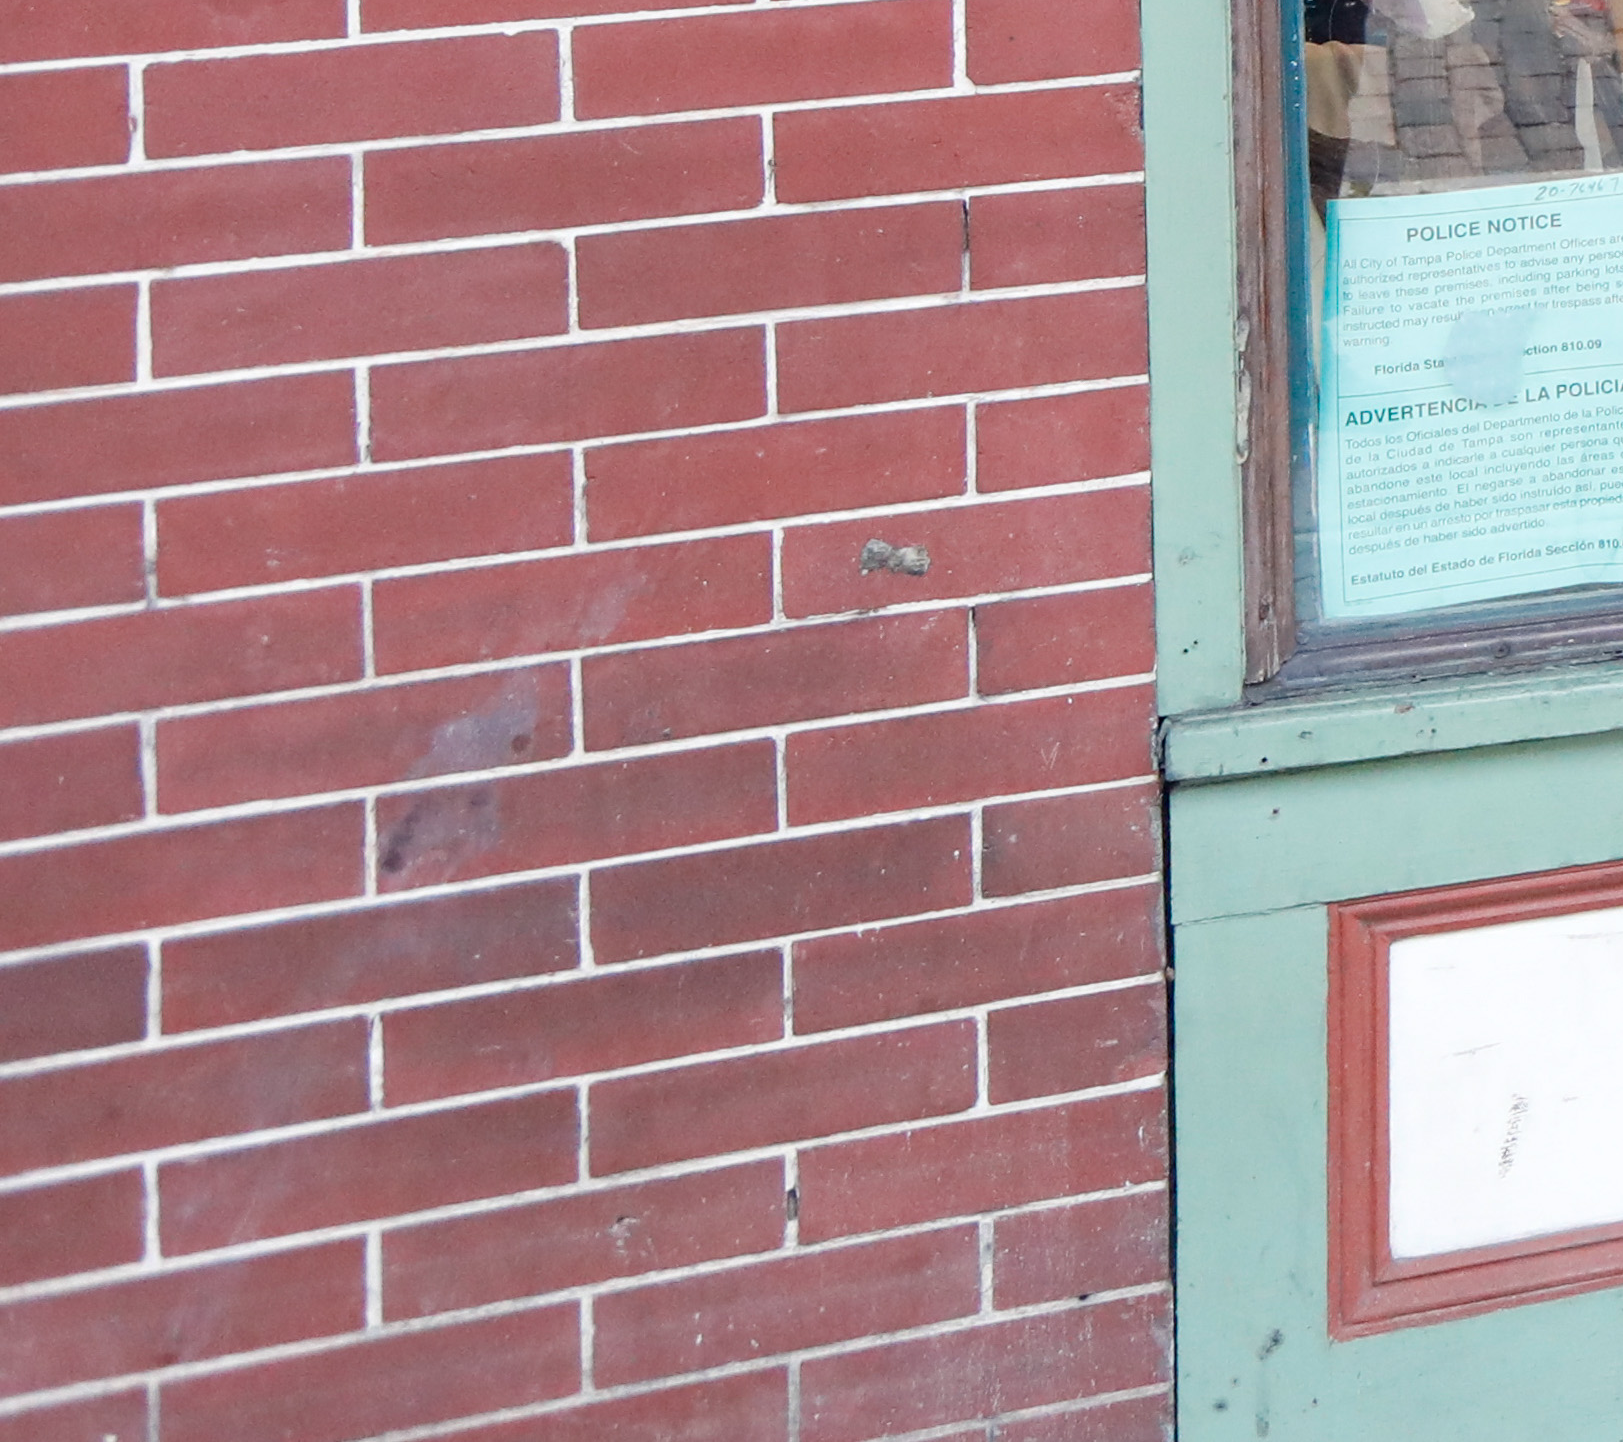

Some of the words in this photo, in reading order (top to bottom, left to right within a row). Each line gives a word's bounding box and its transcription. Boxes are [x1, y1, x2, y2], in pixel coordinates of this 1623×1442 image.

[1406, 222, 1481, 241] POLICE
[1487, 213, 1562, 233] NOTICE
[1342, 271, 1403, 286] authorized
[1407, 262, 1500, 280] representatives
[1520, 254, 1558, 268] advise
[1562, 253, 1584, 266] any
[1360, 256, 1381, 271] City
[1401, 252, 1441, 268] Tampa
[1446, 248, 1482, 261] Police
[1486, 241, 1556, 258] Department
[1559, 235, 1605, 248] Officers
[1342, 302, 1384, 318] Failure
[1407, 297, 1449, 311] vacate
[1455, 293, 1475, 306] the
[1480, 287, 1537, 303] premises
[1542, 282, 1569, 296] after
[1575, 279, 1609, 294] being
[1358, 287, 1390, 301] leave
[1395, 284, 1428, 298] these
[1497, 270, 1550, 286] including
[1555, 264, 1599, 281] parking
[1343, 318, 1399, 332] instructed
[1403, 315, 1428, 330] may
[1551, 296, 1601, 311] trespass
[1373, 362, 1419, 375] Florida
[1560, 338, 1601, 353] 810.09
[1525, 386, 1550, 403] LA
[1350, 569, 1404, 584] Estatuto
[1407, 564, 1427, 576] del
[1431, 557, 1475, 573] Estado
[1479, 554, 1494, 566] de
[1498, 547, 1541, 563] Florida
